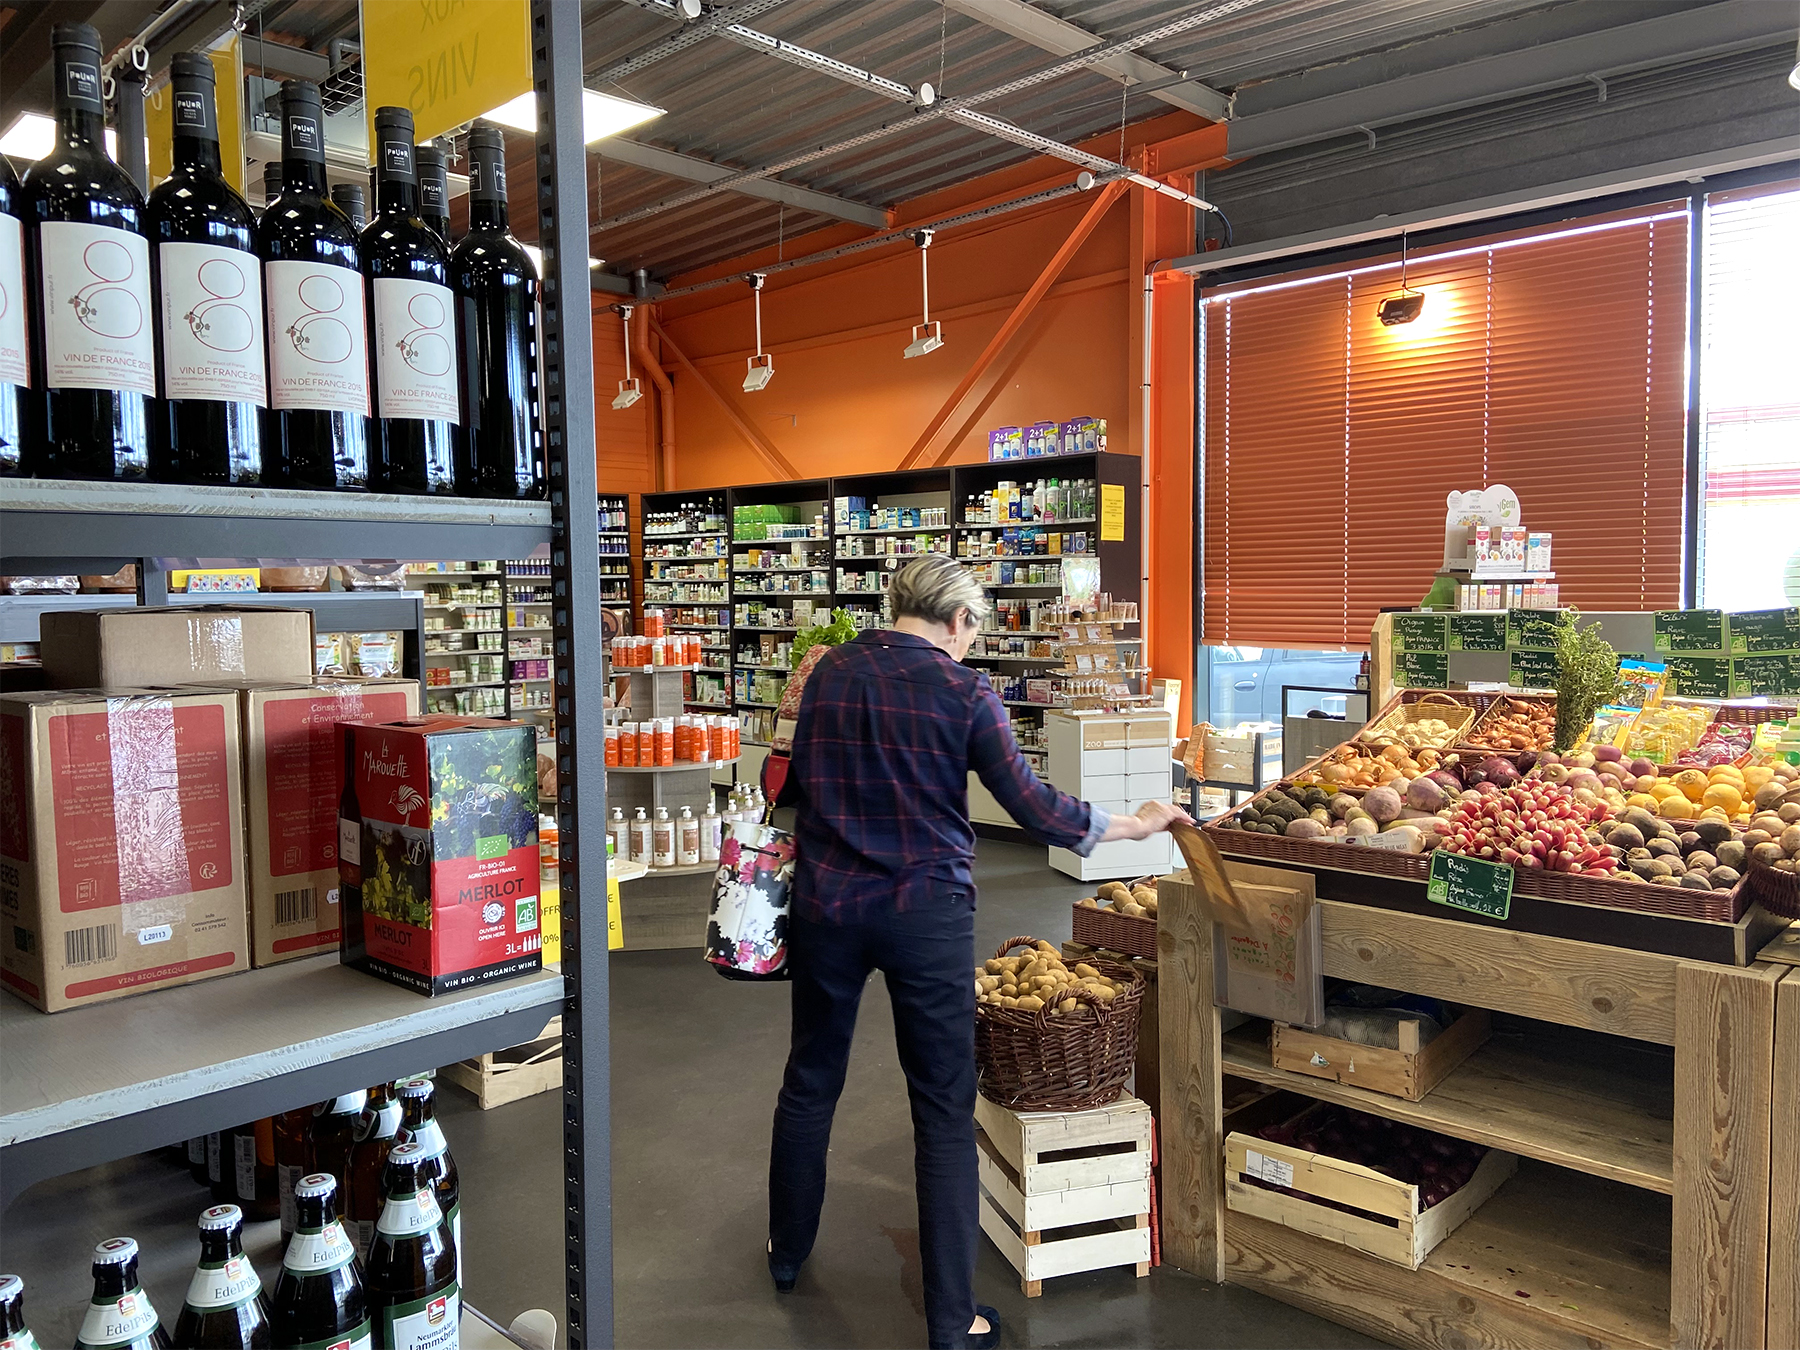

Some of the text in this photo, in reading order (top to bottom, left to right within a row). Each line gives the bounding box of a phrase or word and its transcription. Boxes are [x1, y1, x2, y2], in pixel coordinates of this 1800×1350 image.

[63, 353, 81, 362] VIN
[83, 354, 98, 363] DE
[100, 355, 137, 368] FRANCE
[138, 360, 151, 371] 2015
[179, 366, 262, 382] VIN DE FRANCE 2015
[282, 378, 362, 392] VIN DE FRANCE 2015
[391, 389, 407, 397] VIN
[407, 389, 419, 397] DE
[420, 390, 448, 400] FRANCE
[1029, 428, 1044, 438] 2+1
[1067, 423, 1082, 434] 2+1
[994, 432, 1008, 442] 2+1
[1793, 641, 1800, 649] €
[310, 701, 365, 713] Conservation
[301, 711, 374, 724] et Environnement
[95, 732, 107, 742] et
[478, 860, 506, 871] FR-BIO-01
[467, 865, 517, 880] AGRICULTURE FRANCE
[458, 877, 524, 905] MERLOT
[1430, 884, 1445, 895] AB
[517, 908, 534, 924] AB
[1494, 906, 1504, 915] €
[143, 931, 166, 942] L20113
[374, 923, 413, 947] MERLOT
[478, 925, 498, 935] OUVRIR
[492, 930, 506, 938] HERE
[118, 965, 189, 985] VIN BIOLOGIQUE
[444, 959, 537, 988] VIN BIO ORGANIC WINE
[312, 1241, 351, 1264] EdelPils
[214, 1276, 256, 1300] EdelPils
[105, 1312, 152, 1337] EdelPils
[416, 1320, 454, 1342] Neumarkter
